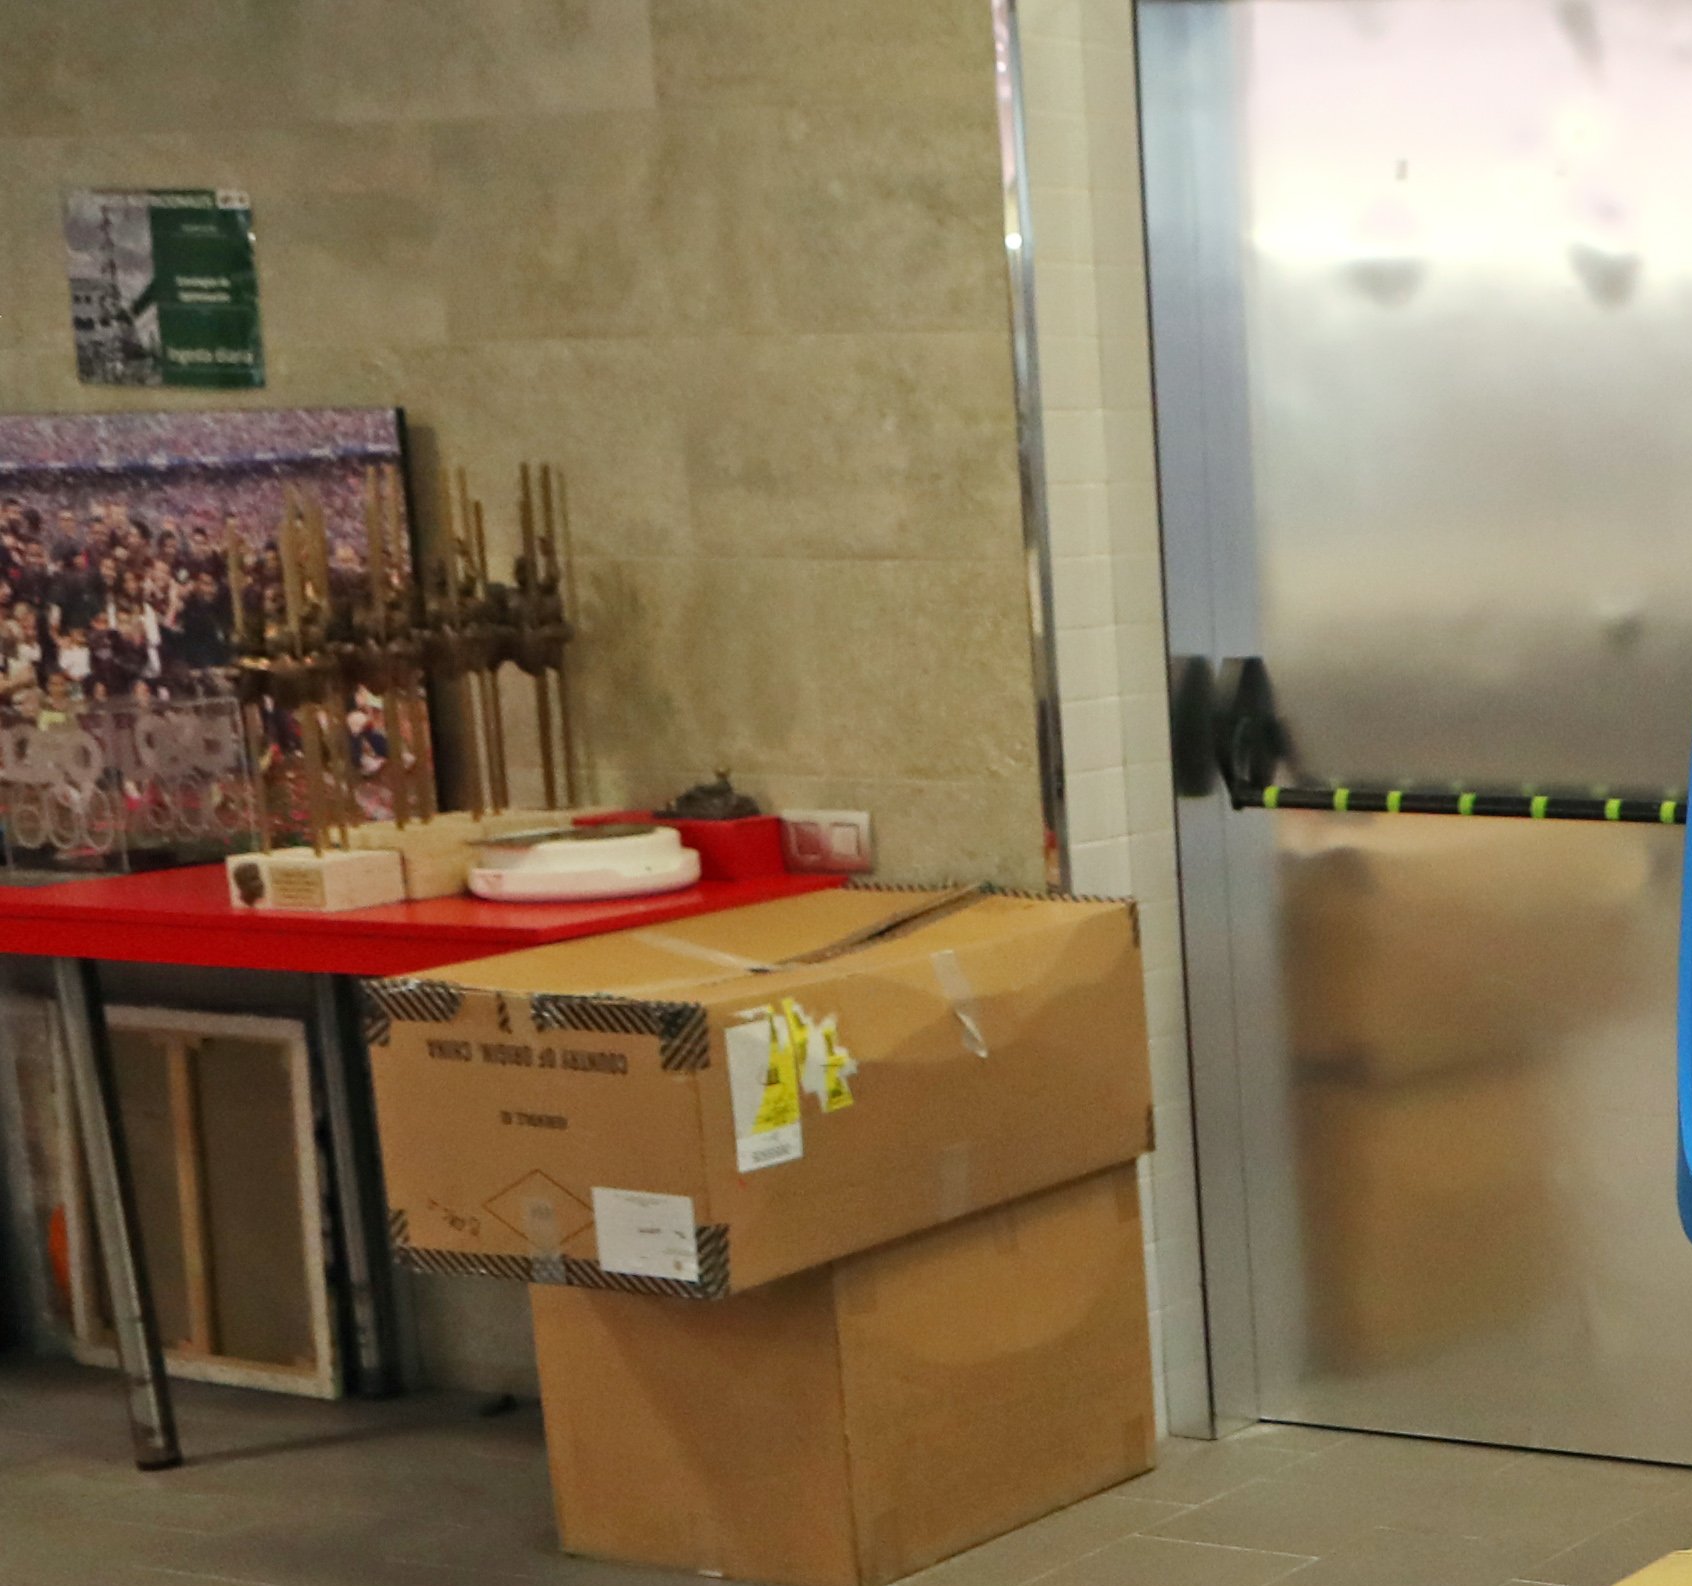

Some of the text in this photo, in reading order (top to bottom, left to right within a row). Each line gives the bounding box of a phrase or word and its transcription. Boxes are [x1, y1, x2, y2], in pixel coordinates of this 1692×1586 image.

[426, 1038, 472, 1062] CHINA
[538, 1047, 557, 1068] OF
[561, 1049, 629, 1075] COUNTRY
